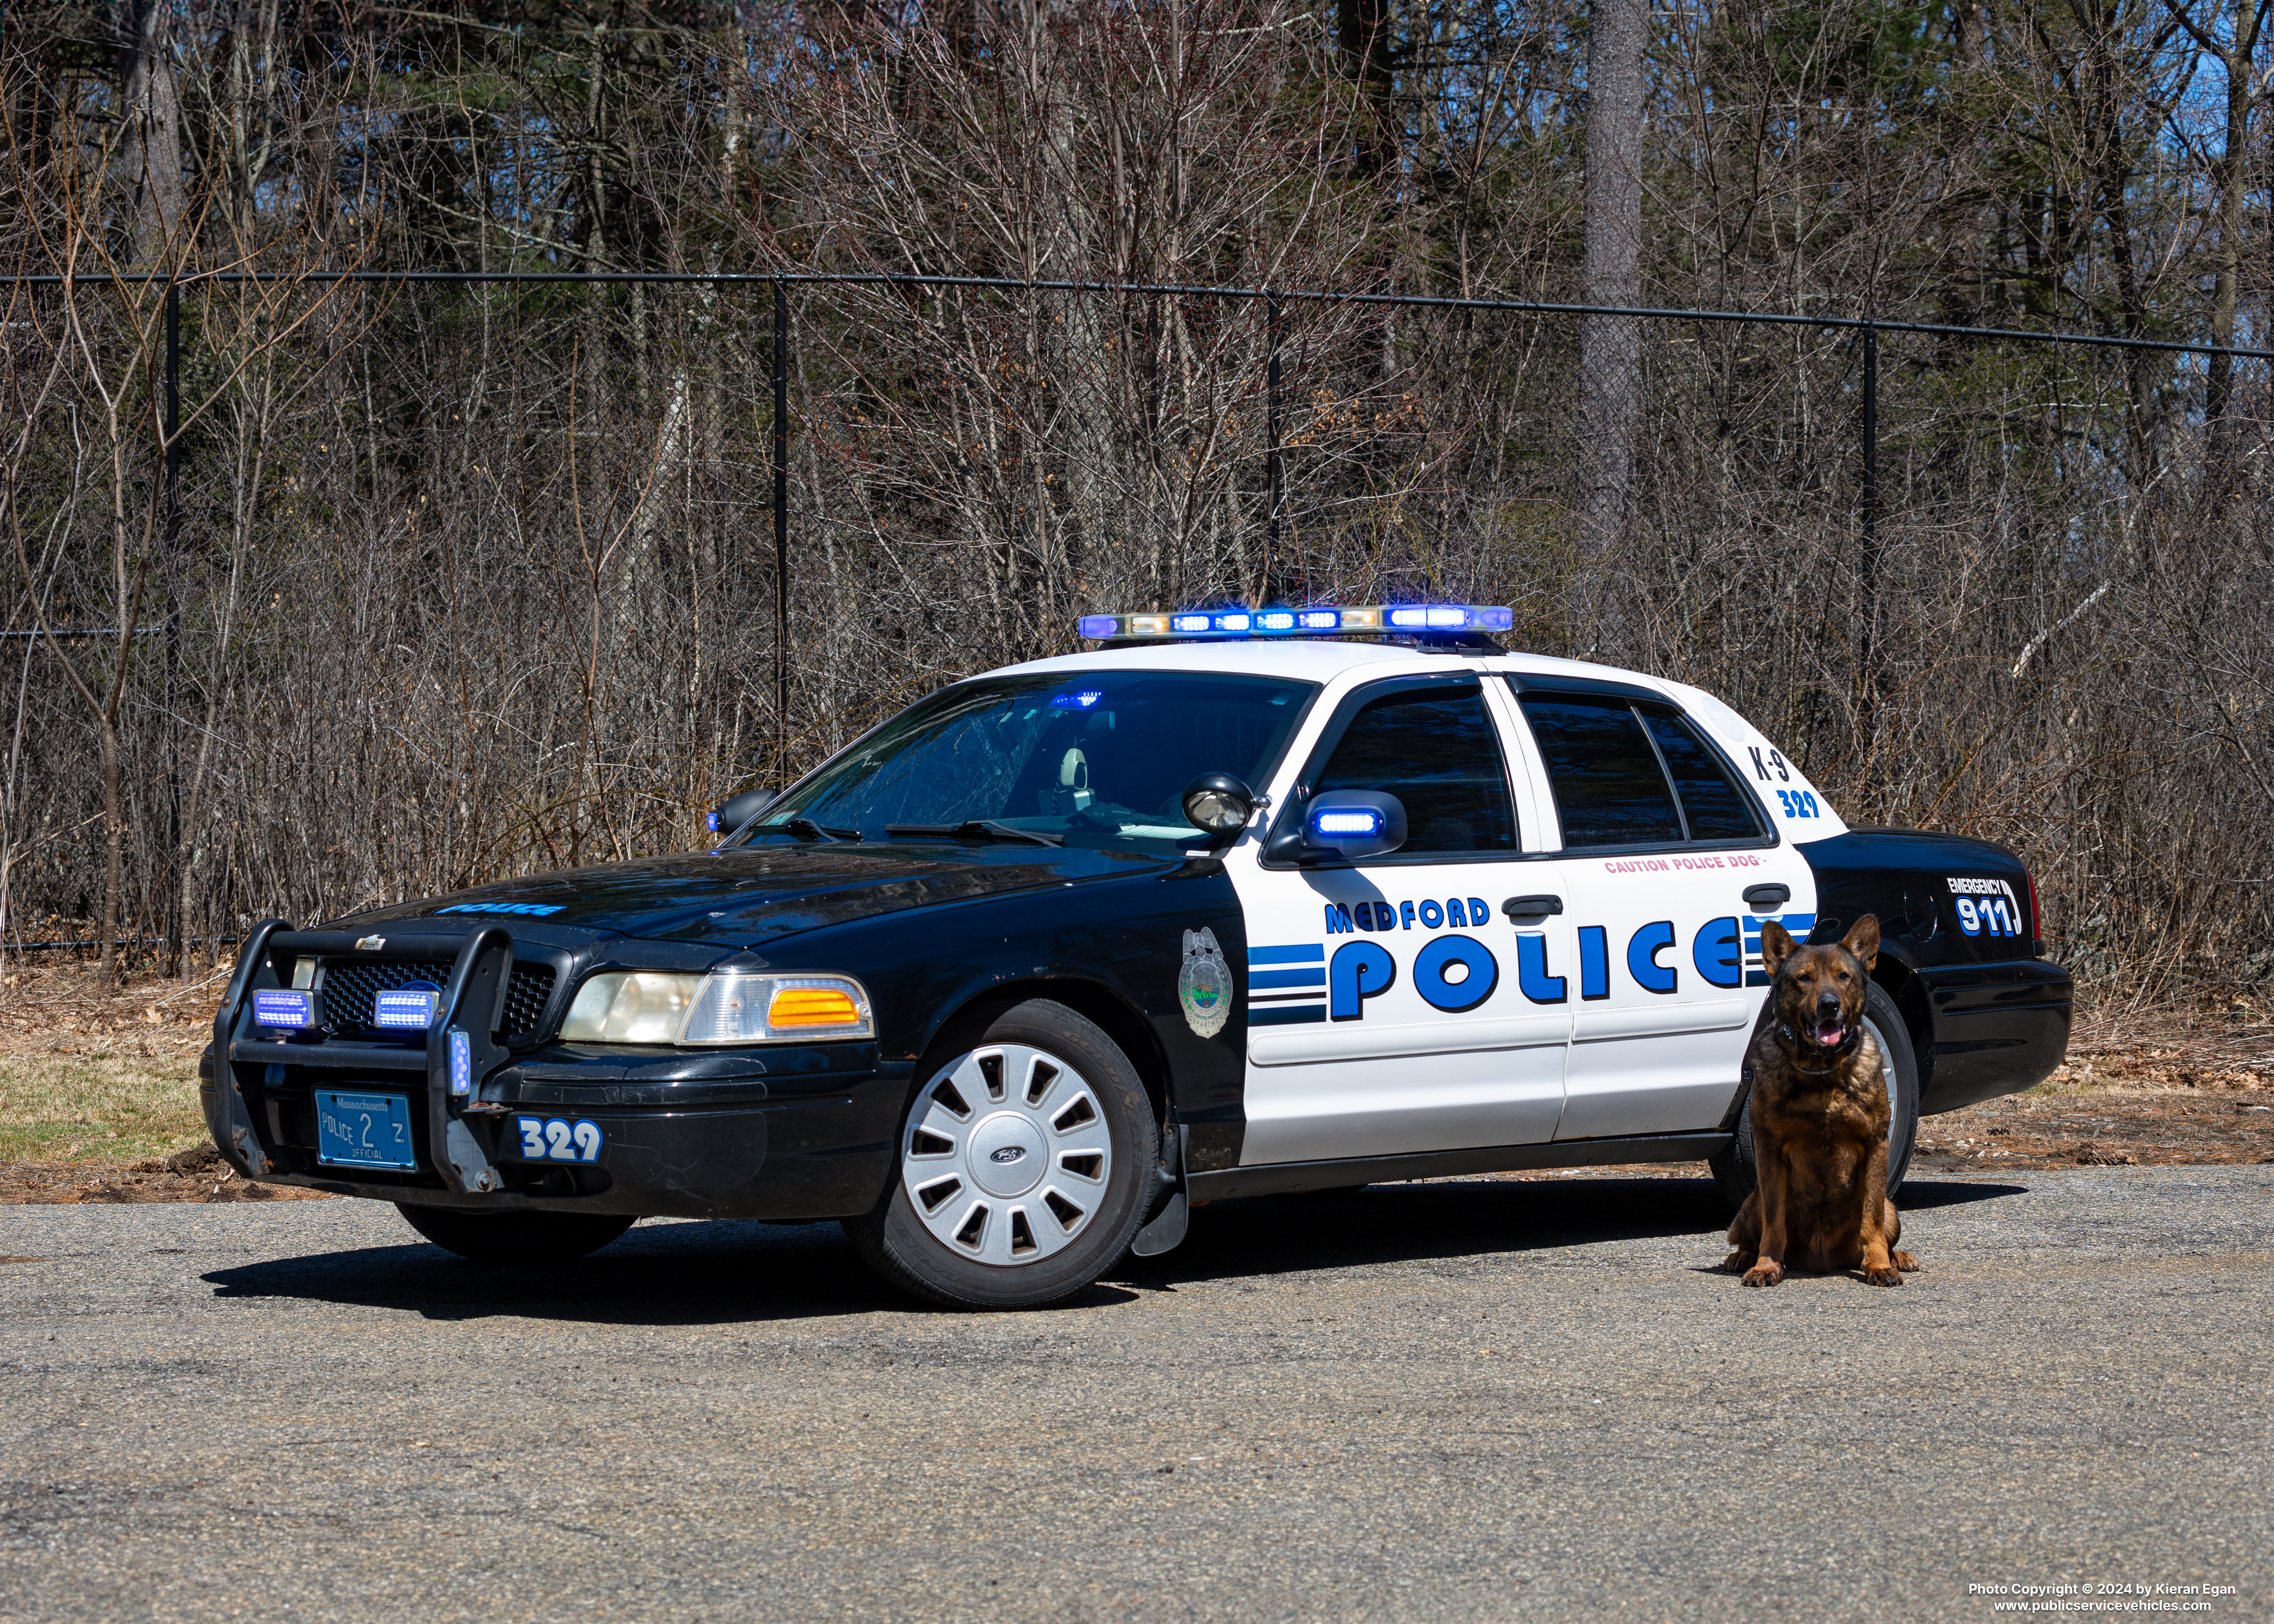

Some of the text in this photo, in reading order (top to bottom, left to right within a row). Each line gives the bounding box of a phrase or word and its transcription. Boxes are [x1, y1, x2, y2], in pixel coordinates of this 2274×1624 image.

[1748, 746, 1789, 782] K-9
[1776, 790, 1819, 818] 329
[1605, 855, 1760, 873] CAUTION POLICE DOG
[1947, 878, 2001, 894] EMERGENCY
[434, 902, 567, 916] POLICE
[1325, 897, 1489, 934] MEDFORD
[1956, 897, 2013, 936] 911
[1330, 917, 1742, 1022] POLICE
[337, 1097, 388, 1112] Massachusetts
[1062, 1027, 1140, 1166] GOODYEAR
[322, 1110, 404, 1148] POLICE 2 Z
[517, 1116, 603, 1163] 329
[352, 1148, 383, 1159] OFFICIAL
[998, 1150, 1017, 1160] Ford
